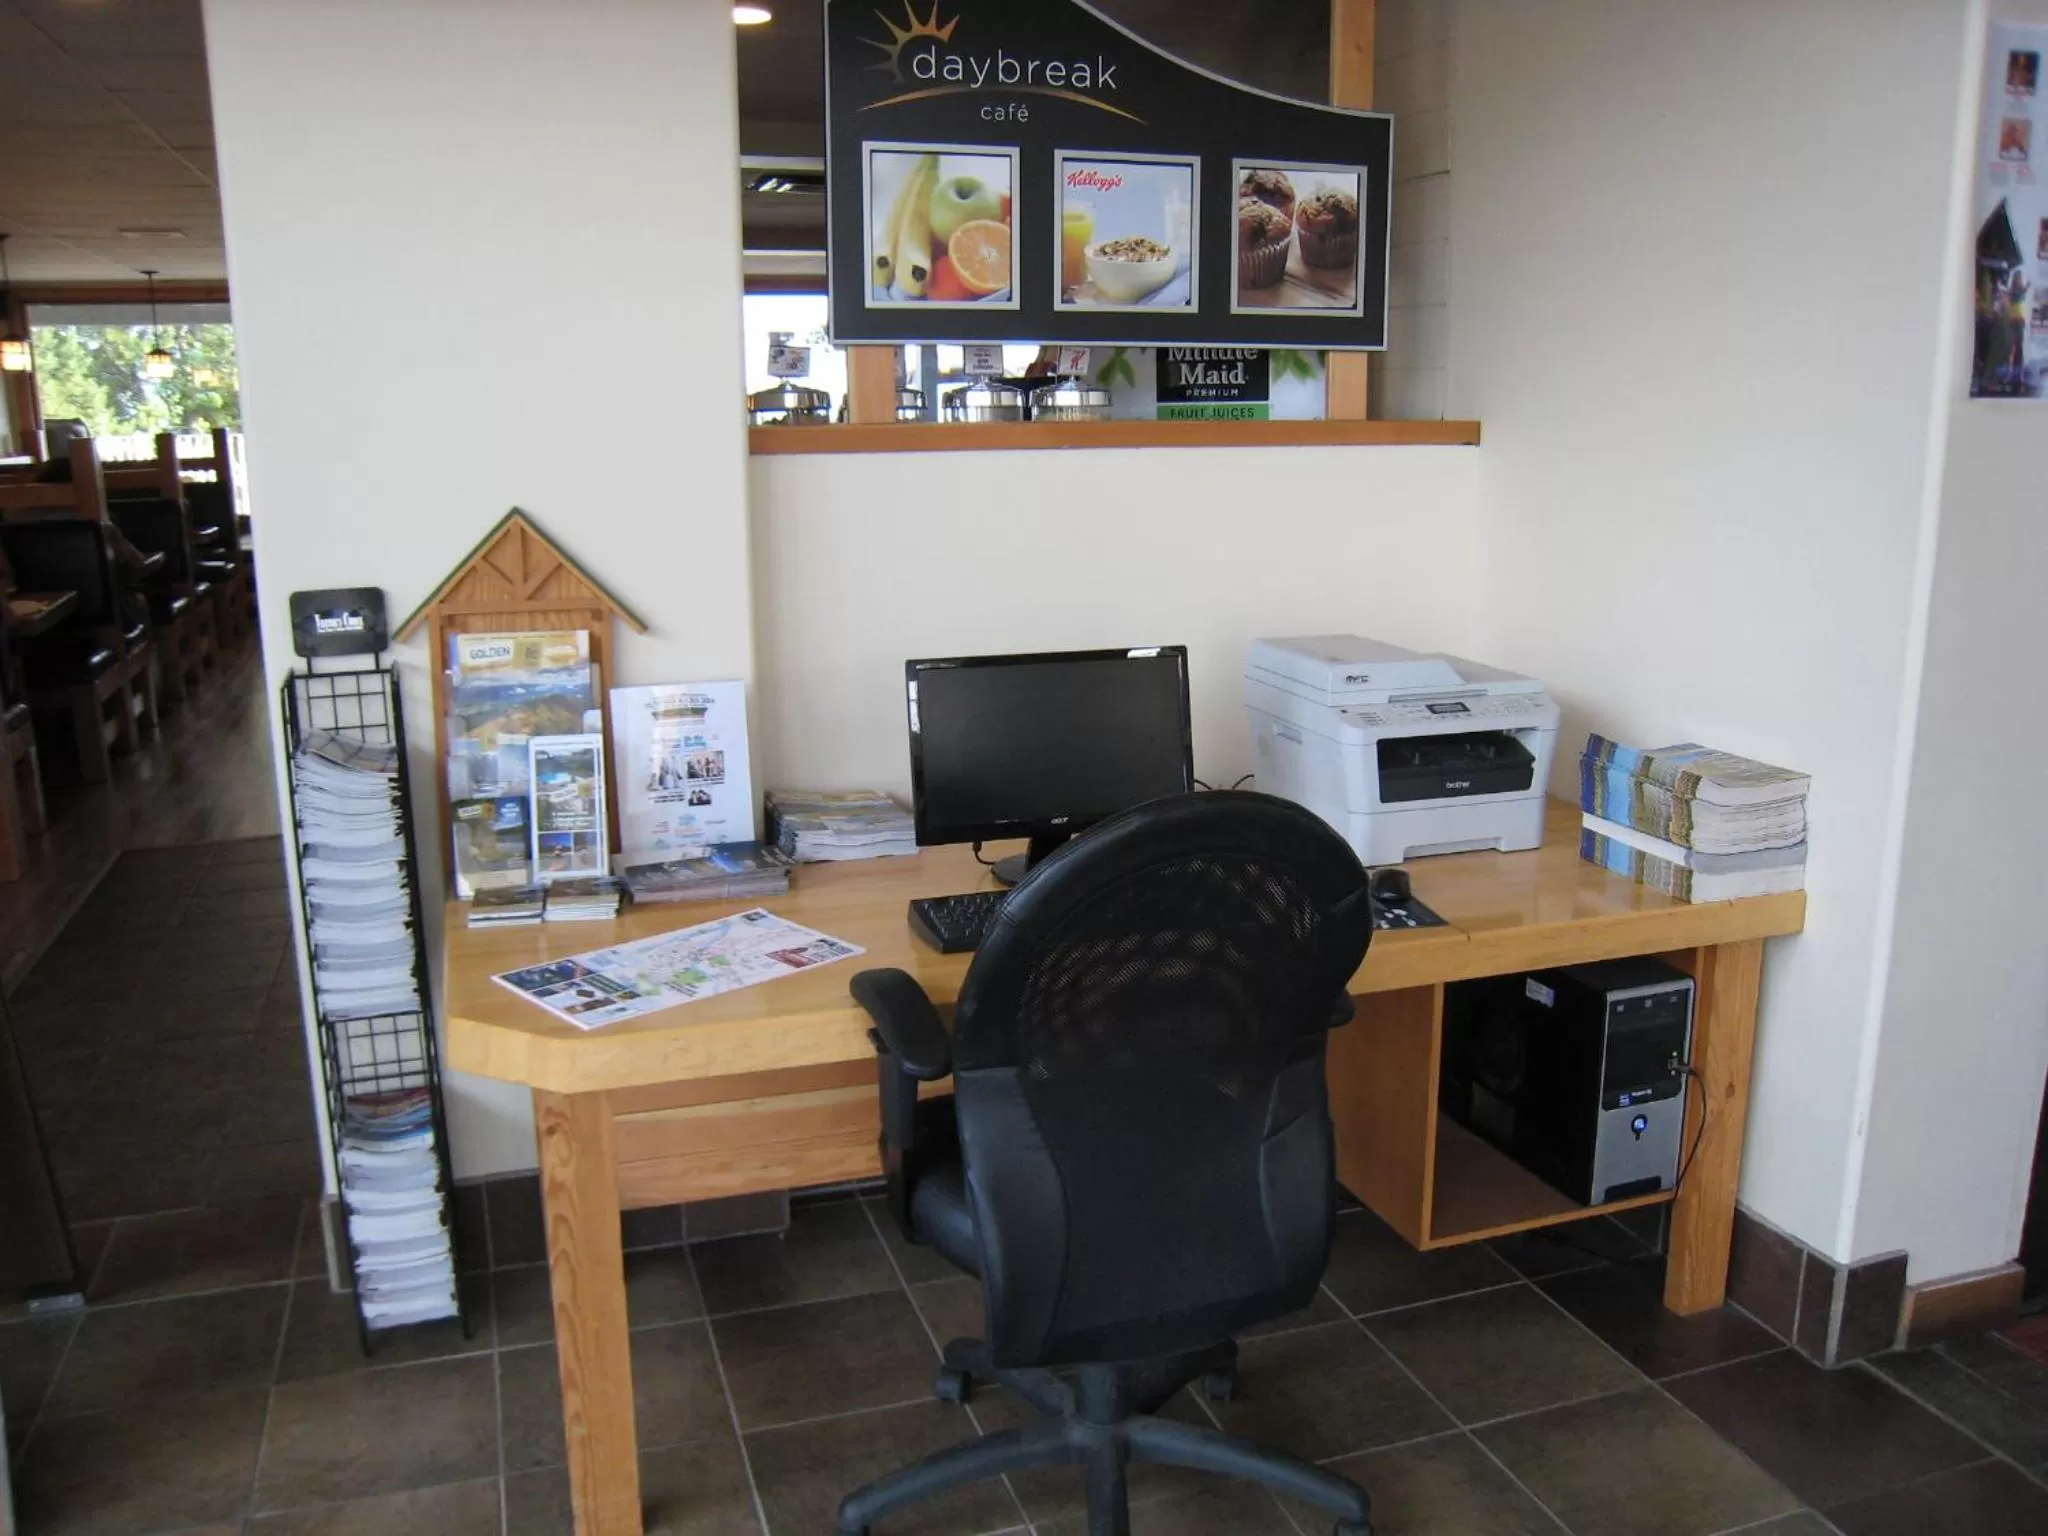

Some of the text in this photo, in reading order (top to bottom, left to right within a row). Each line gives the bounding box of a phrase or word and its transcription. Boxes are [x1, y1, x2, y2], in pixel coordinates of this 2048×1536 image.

[913, 45, 1117, 90] daybreak
[980, 103, 1029, 122] café
[1067, 169, 1122, 191] Kellogg's
[1180, 362, 1246, 385] Maid
[1186, 388, 1239, 397] PREMIUM
[1170, 407, 1255, 418] FRUIT JUICES
[469, 646, 510, 660] GOLDEN
